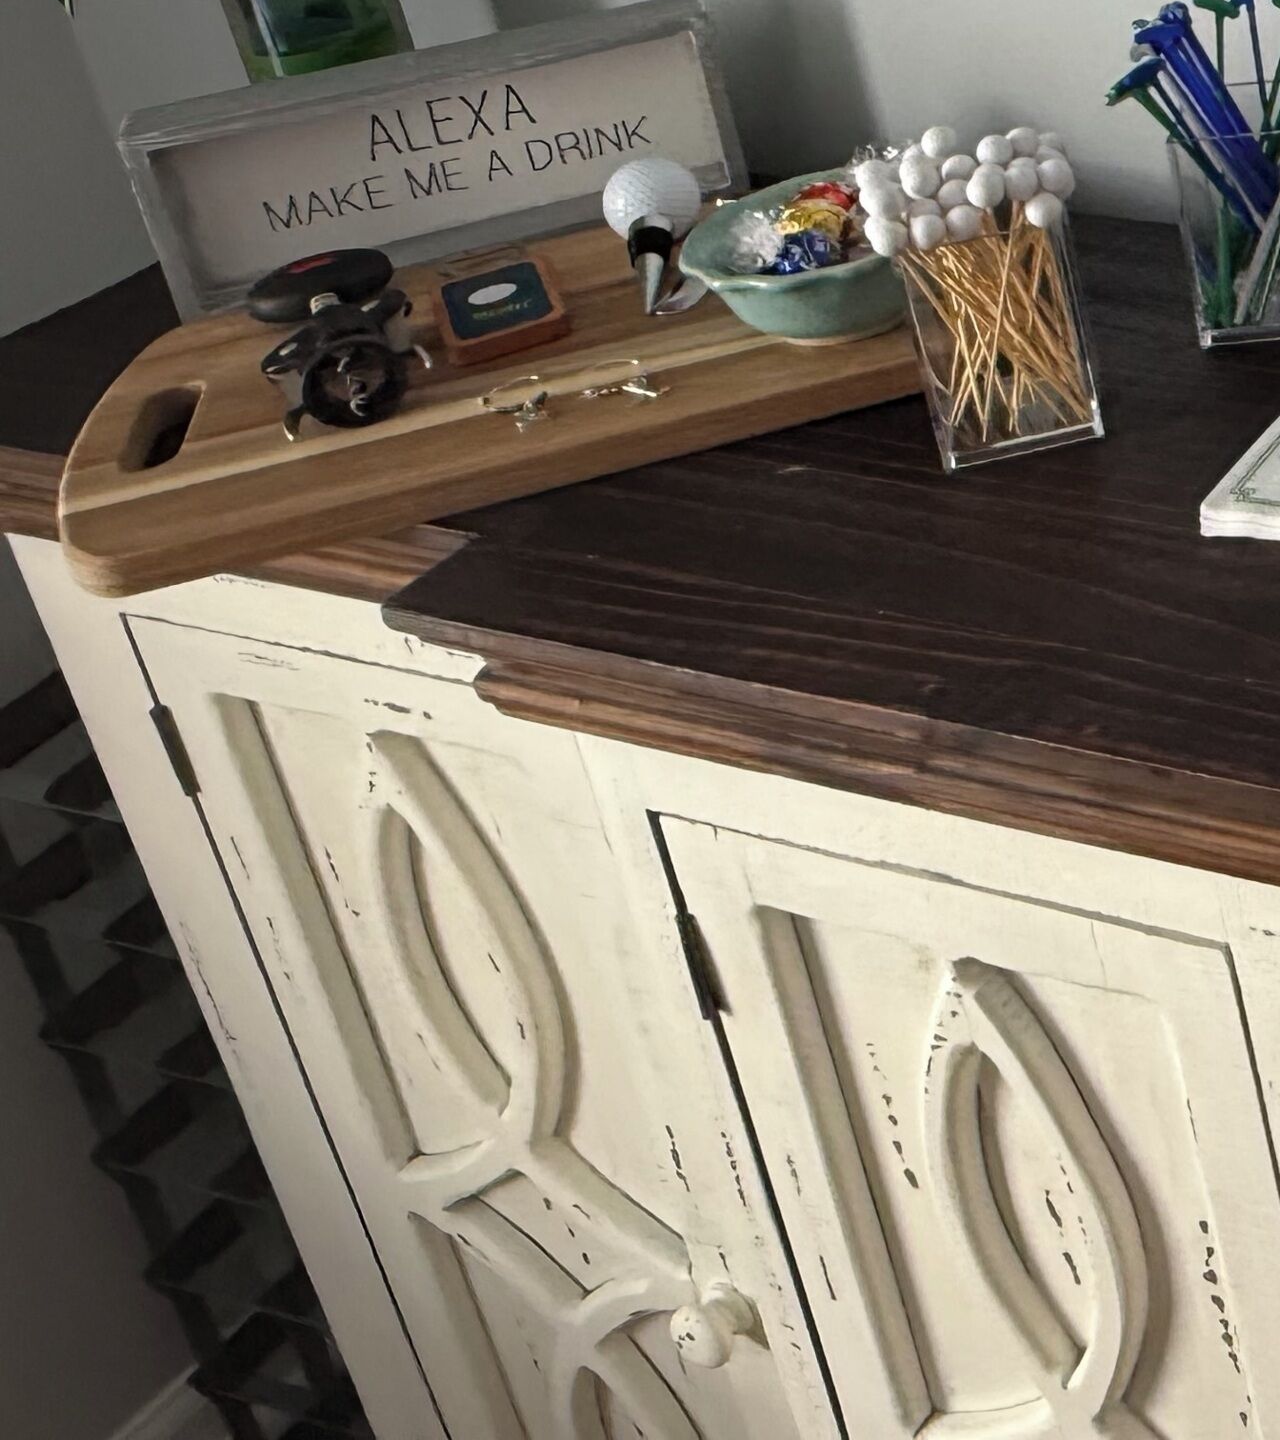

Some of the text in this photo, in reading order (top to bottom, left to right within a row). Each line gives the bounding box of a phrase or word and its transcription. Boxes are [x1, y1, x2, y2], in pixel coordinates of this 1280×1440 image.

[370, 84, 536, 161] ALEXA
[262, 115, 652, 232] MAKE ME A DRINK
